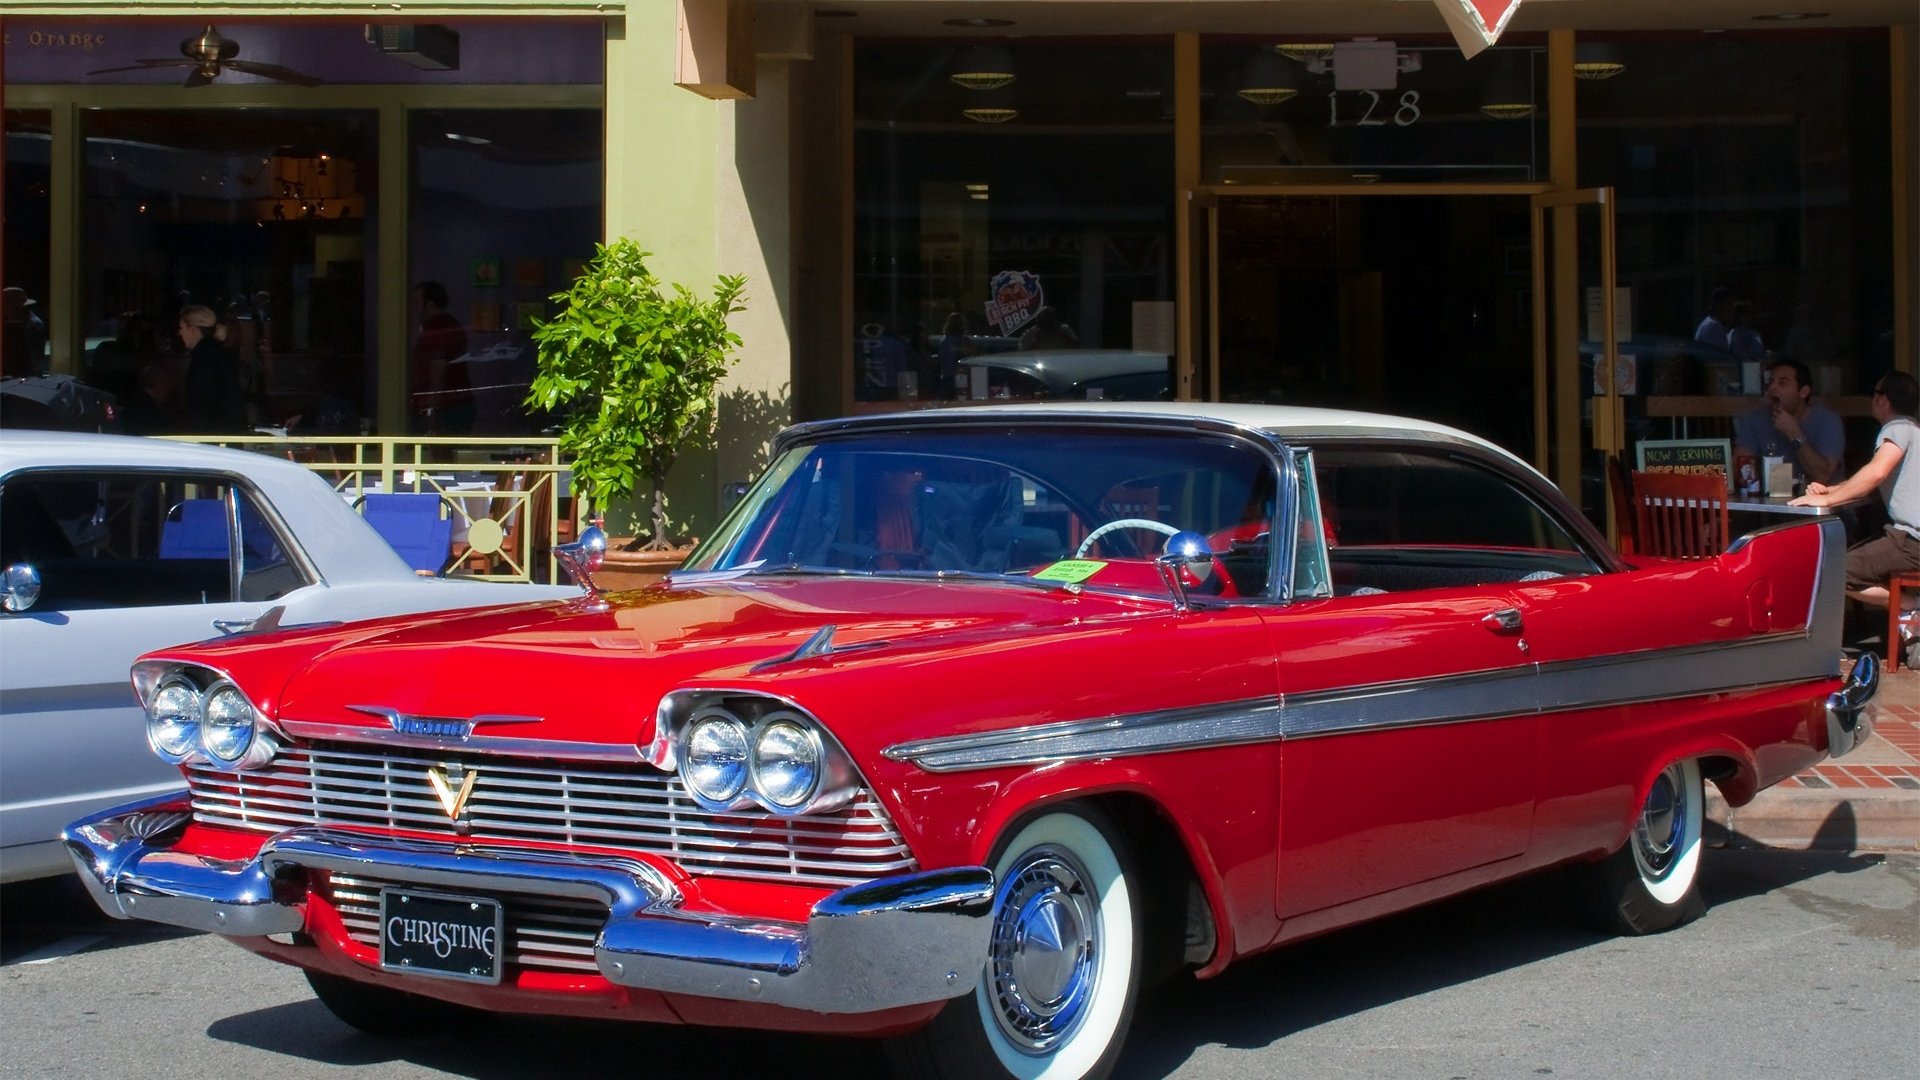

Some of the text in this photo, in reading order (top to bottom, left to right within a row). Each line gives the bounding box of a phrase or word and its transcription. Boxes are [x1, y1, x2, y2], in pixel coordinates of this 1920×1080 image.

[1327, 89, 1421, 126] 128
[1004, 308, 1030, 330] BBQ
[1646, 447, 1722, 462] NOW SERVING
[387, 916, 496, 958] CHRISTINE
